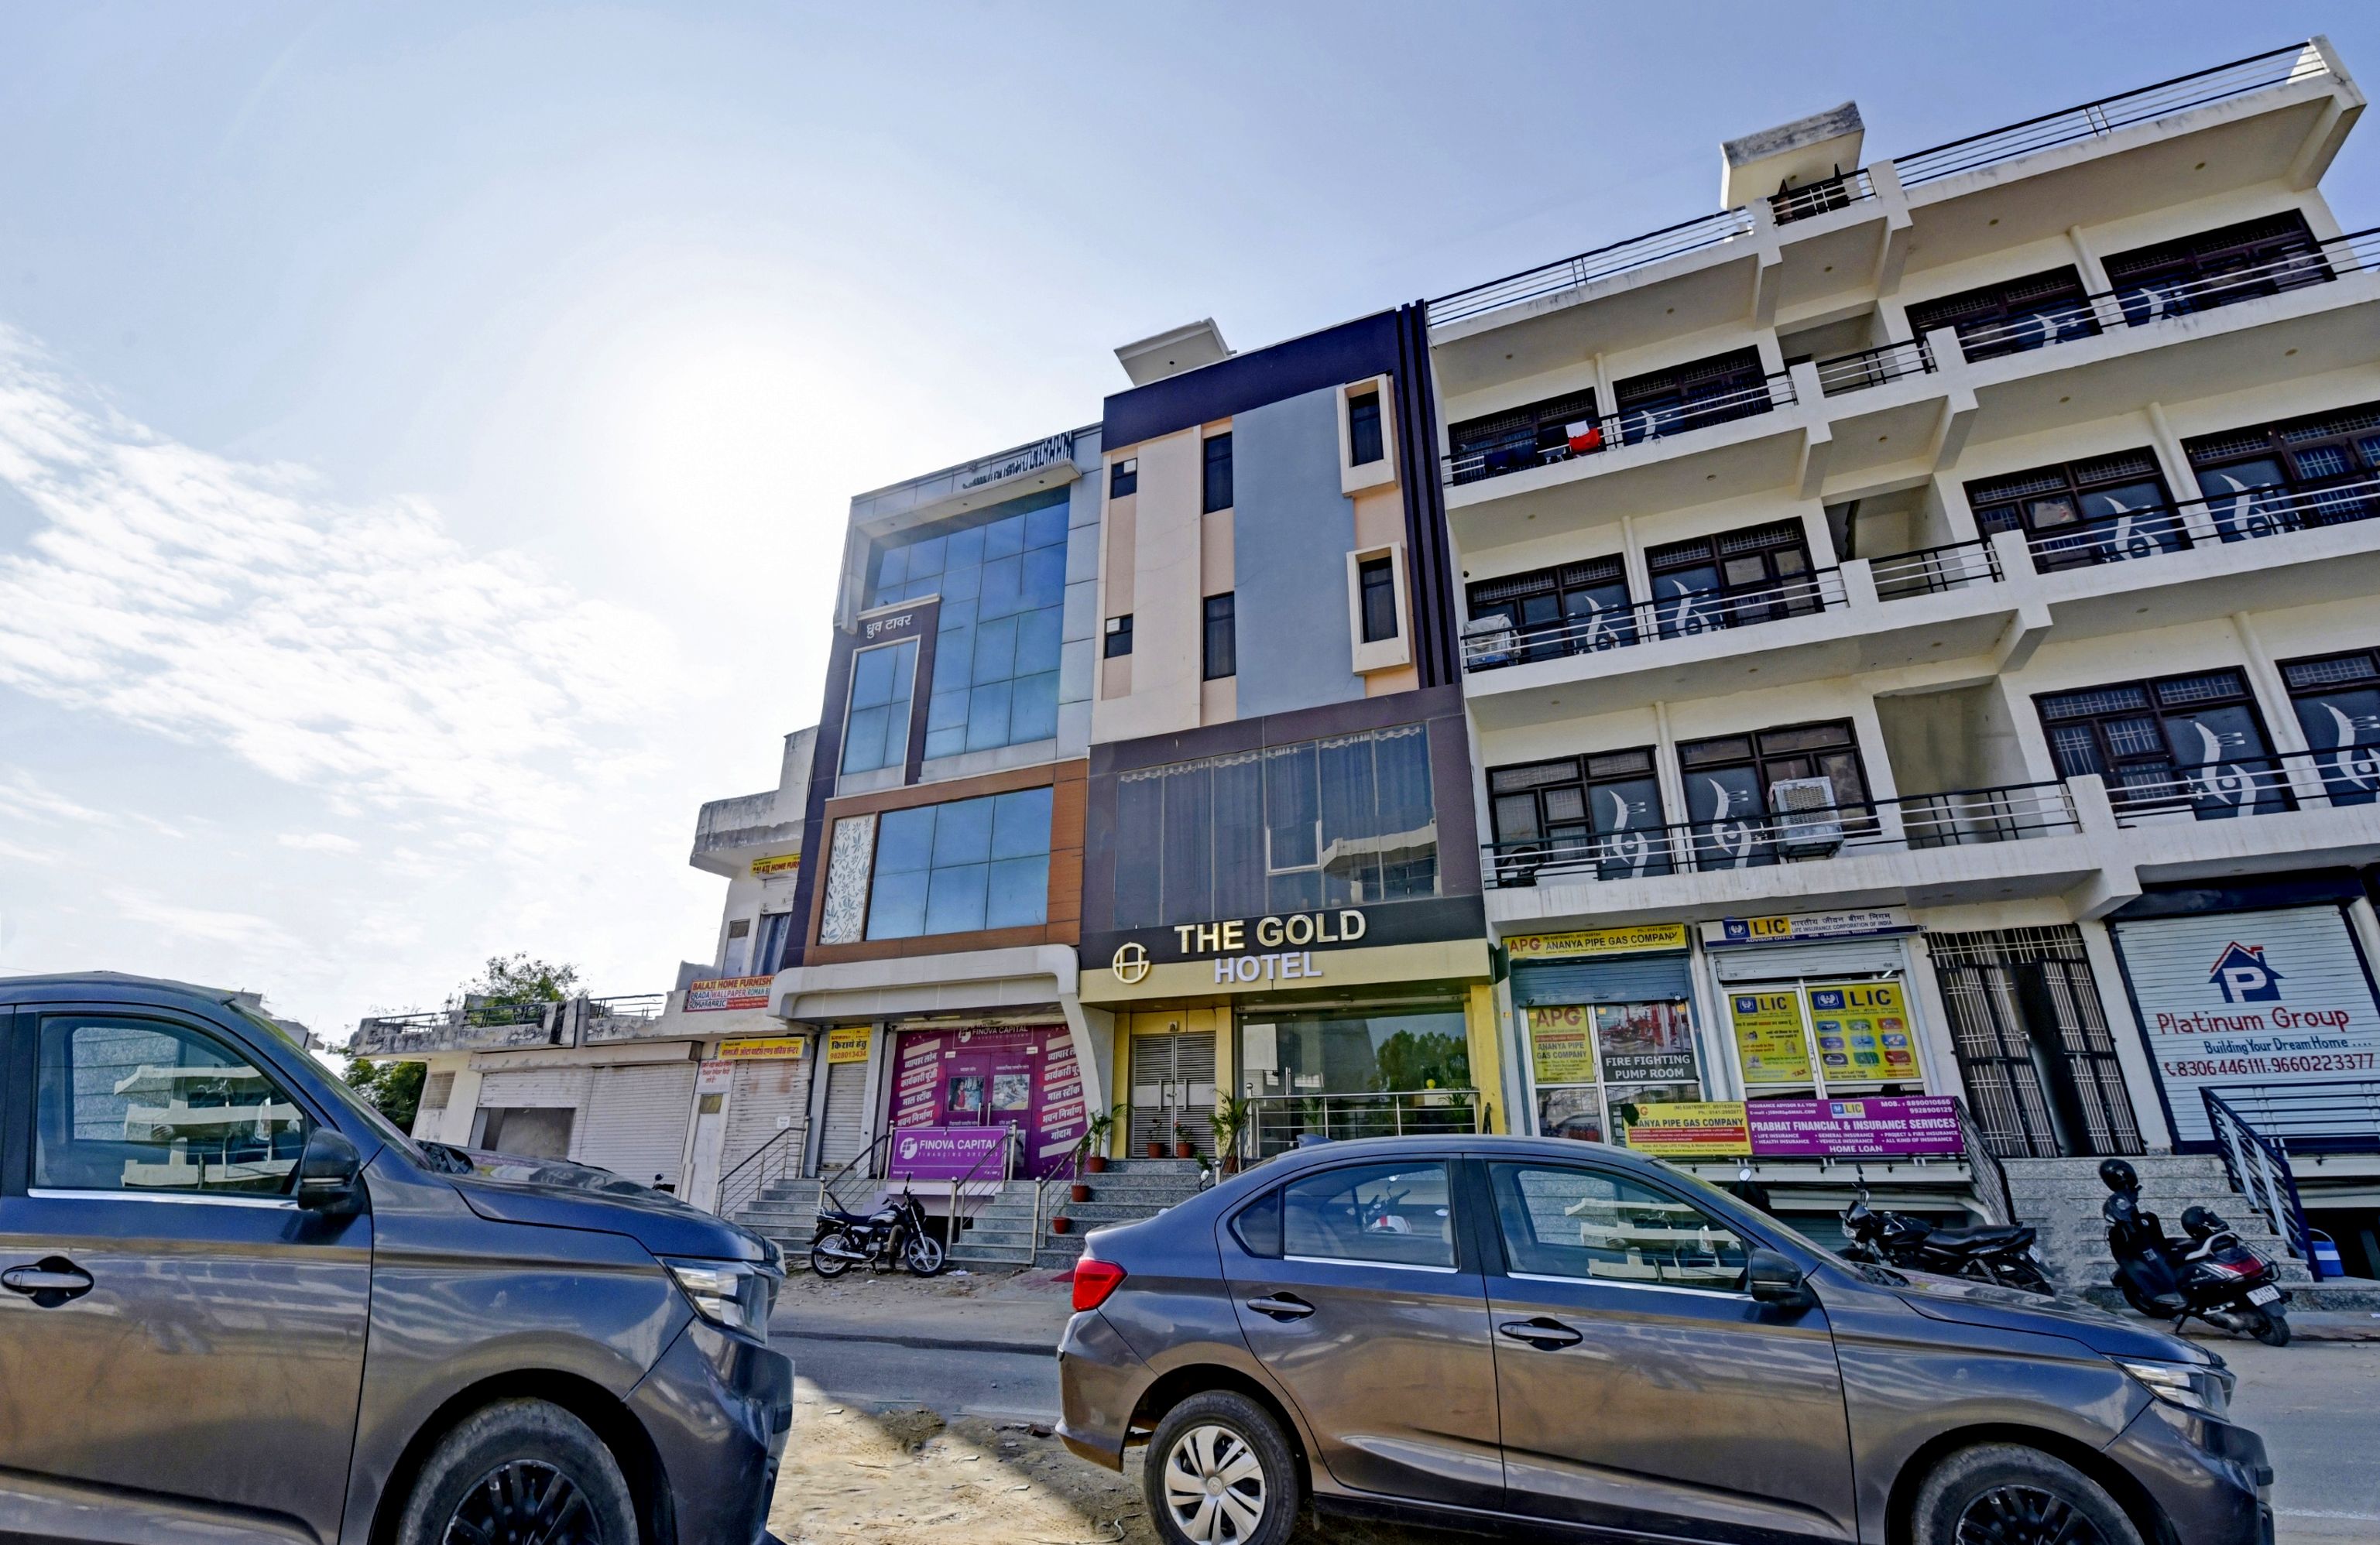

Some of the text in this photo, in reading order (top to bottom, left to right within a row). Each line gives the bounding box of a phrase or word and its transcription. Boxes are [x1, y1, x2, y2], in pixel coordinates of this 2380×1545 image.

[866, 614, 913, 639] ध्रुव टावर
[1753, 919, 1786, 935] LIC
[1791, 912, 1891, 927] भारतीय जीवन बीमा निगम
[1175, 910, 1367, 954] THE GOLD
[1510, 937, 1542, 952] APG
[1546, 939, 1583, 950] ANANYA
[1585, 937, 1606, 947] PIPE
[1608, 936, 1628, 945] GAS
[1631, 931, 1678, 944] COMPANY
[1214, 951, 1323, 984] HOTEL
[693, 981, 716, 991] BALAJI
[718, 979, 739, 988] HOME
[712, 988, 747, 999] WALLPAPER
[747, 988, 765, 996] ROMAN
[1849, 989, 1891, 1006] LIC
[1759, 997, 1787, 1011] LIC
[1536, 1006, 1583, 1028] APG
[2155, 1006, 2350, 1035] Platinum Group
[972, 1026, 1029, 1036] FINOVA CAPITAL
[2203, 1040, 2247, 1055] Building
[2246, 1039, 2272, 1053] Your
[2272, 1037, 2310, 1050] Dream
[2310, 1036, 2348, 1049] Home
[1048, 1049, 1068, 1060] व्यापार
[1605, 1054, 1691, 1067] FIRE FIGHTING
[1044, 1064, 1072, 1081] कार्यकारी
[1615, 1068, 1685, 1079] PUMP ROOM
[903, 1095, 915, 1105] माल
[1048, 1084, 1080, 1101] माल स्टॉक
[1043, 1105, 1083, 1123] भवन निर्माण
[1845, 1104, 1862, 1113] LIC
[1703, 1118, 1744, 1126] COMPANY
[1751, 1122, 1791, 1131] PRABHAT
[1792, 1121, 1841, 1131] FINANCIAL
[1853, 1120, 1908, 1130] INSURANCE
[1908, 1118, 1956, 1129] SERVICES
[1051, 1127, 1072, 1140] गोदाम
[919, 1139, 998, 1150] FINOVA CAPITAL
